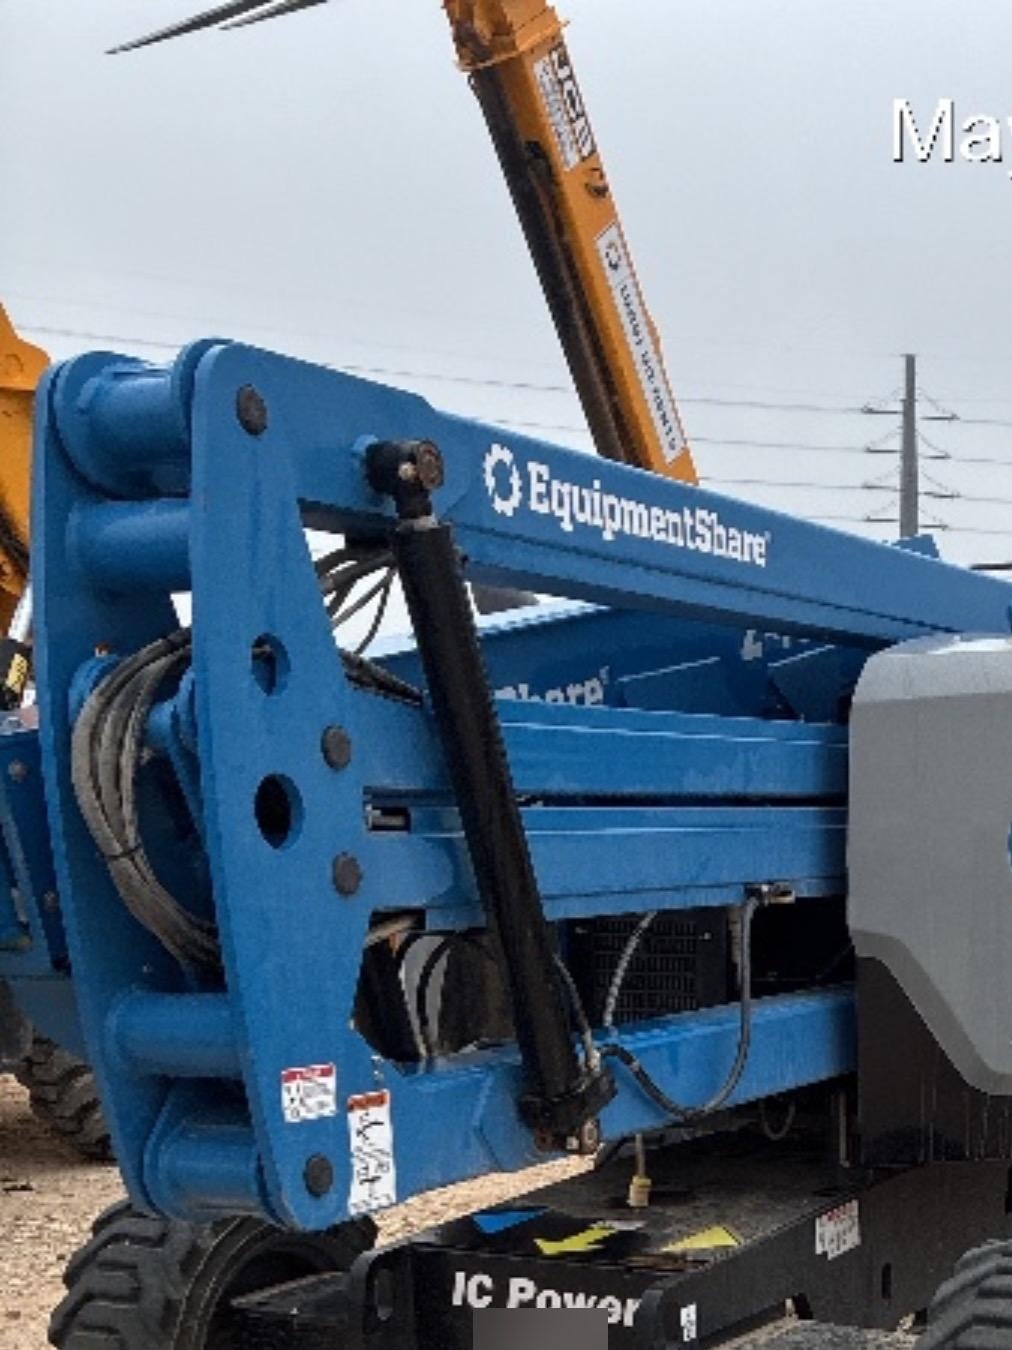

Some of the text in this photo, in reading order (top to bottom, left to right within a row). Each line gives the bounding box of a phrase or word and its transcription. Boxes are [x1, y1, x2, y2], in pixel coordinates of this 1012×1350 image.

[526, 461, 767, 568] EquipmentShare
[453, 1271, 493, 1309] IC
[507, 1277, 642, 1327] Power
